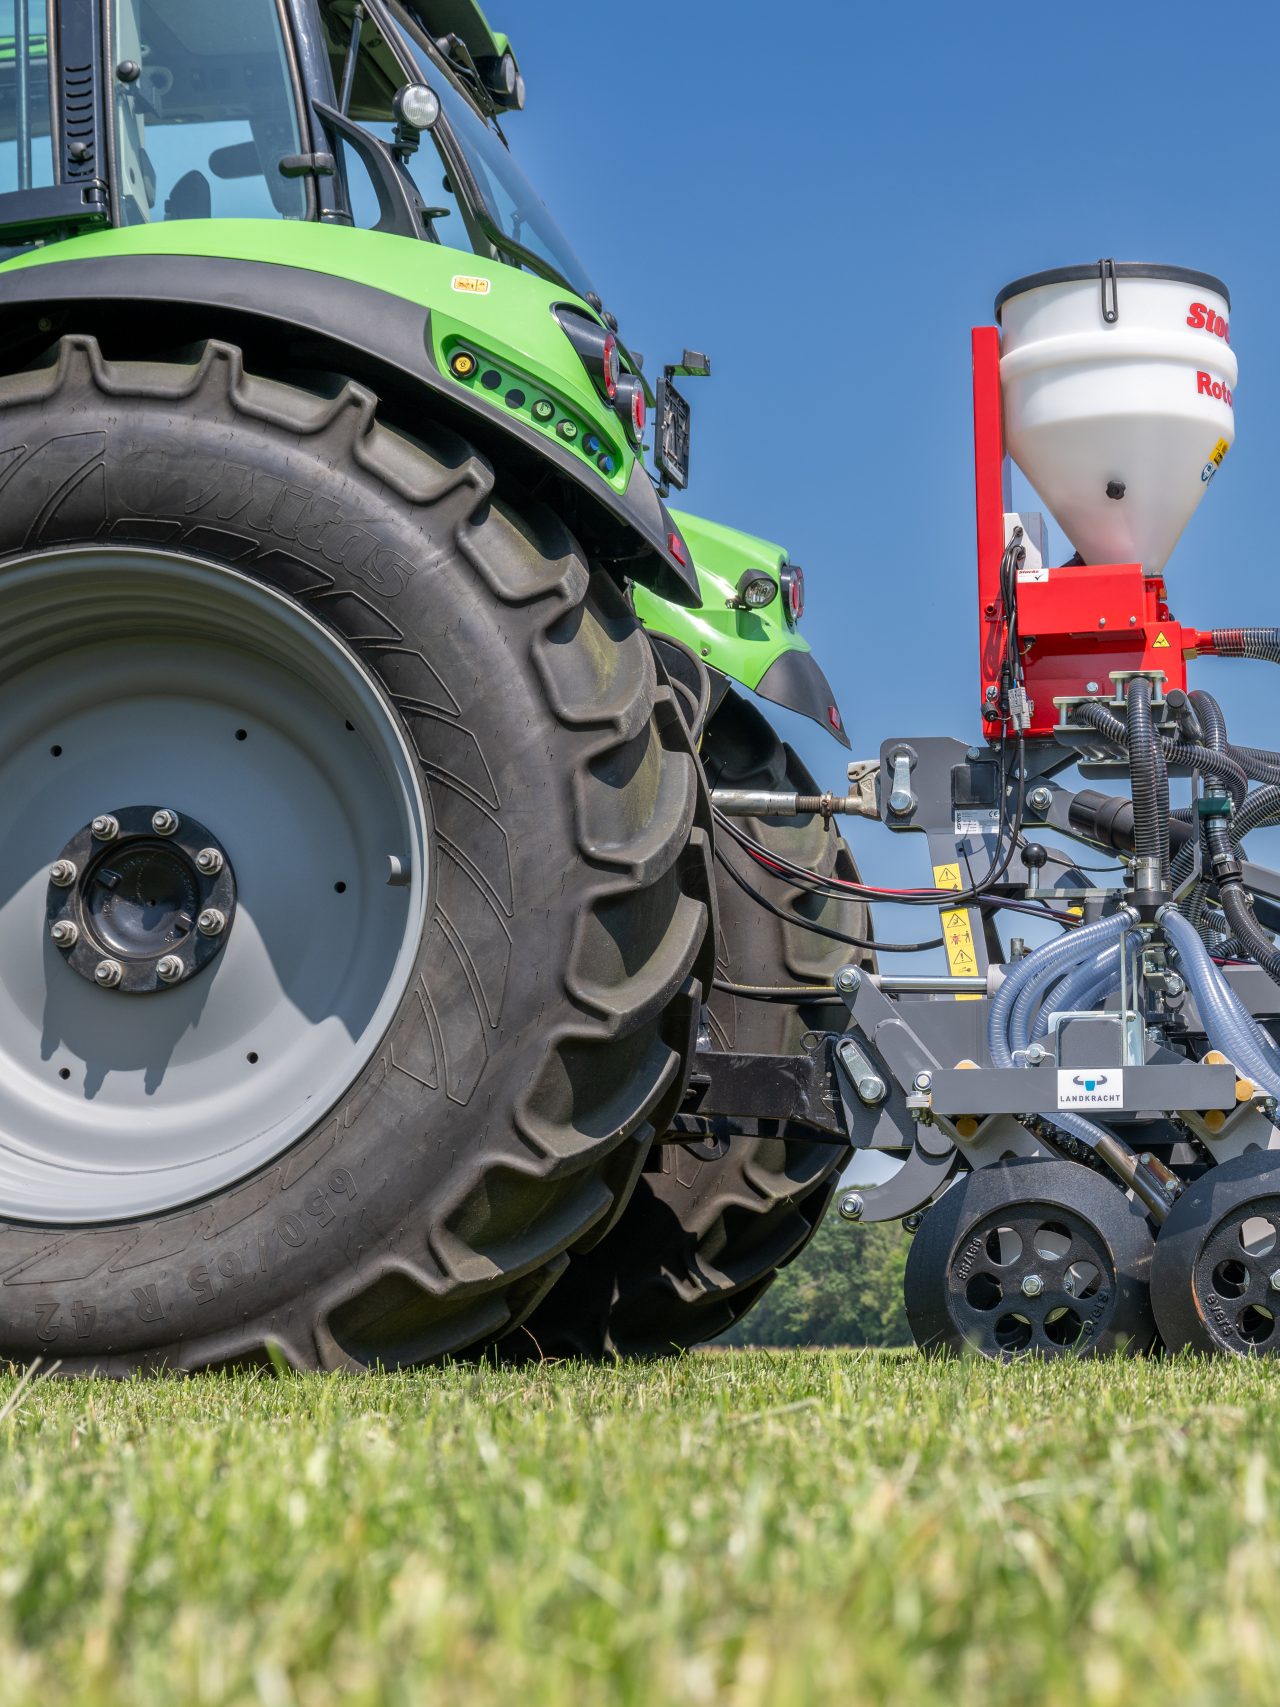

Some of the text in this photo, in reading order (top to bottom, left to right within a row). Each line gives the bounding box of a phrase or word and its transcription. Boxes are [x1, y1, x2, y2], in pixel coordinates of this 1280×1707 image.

[1060, 1094, 1121, 1102] LANDKRACHT
[35, 1167, 358, 1342] 650/65 R 42
